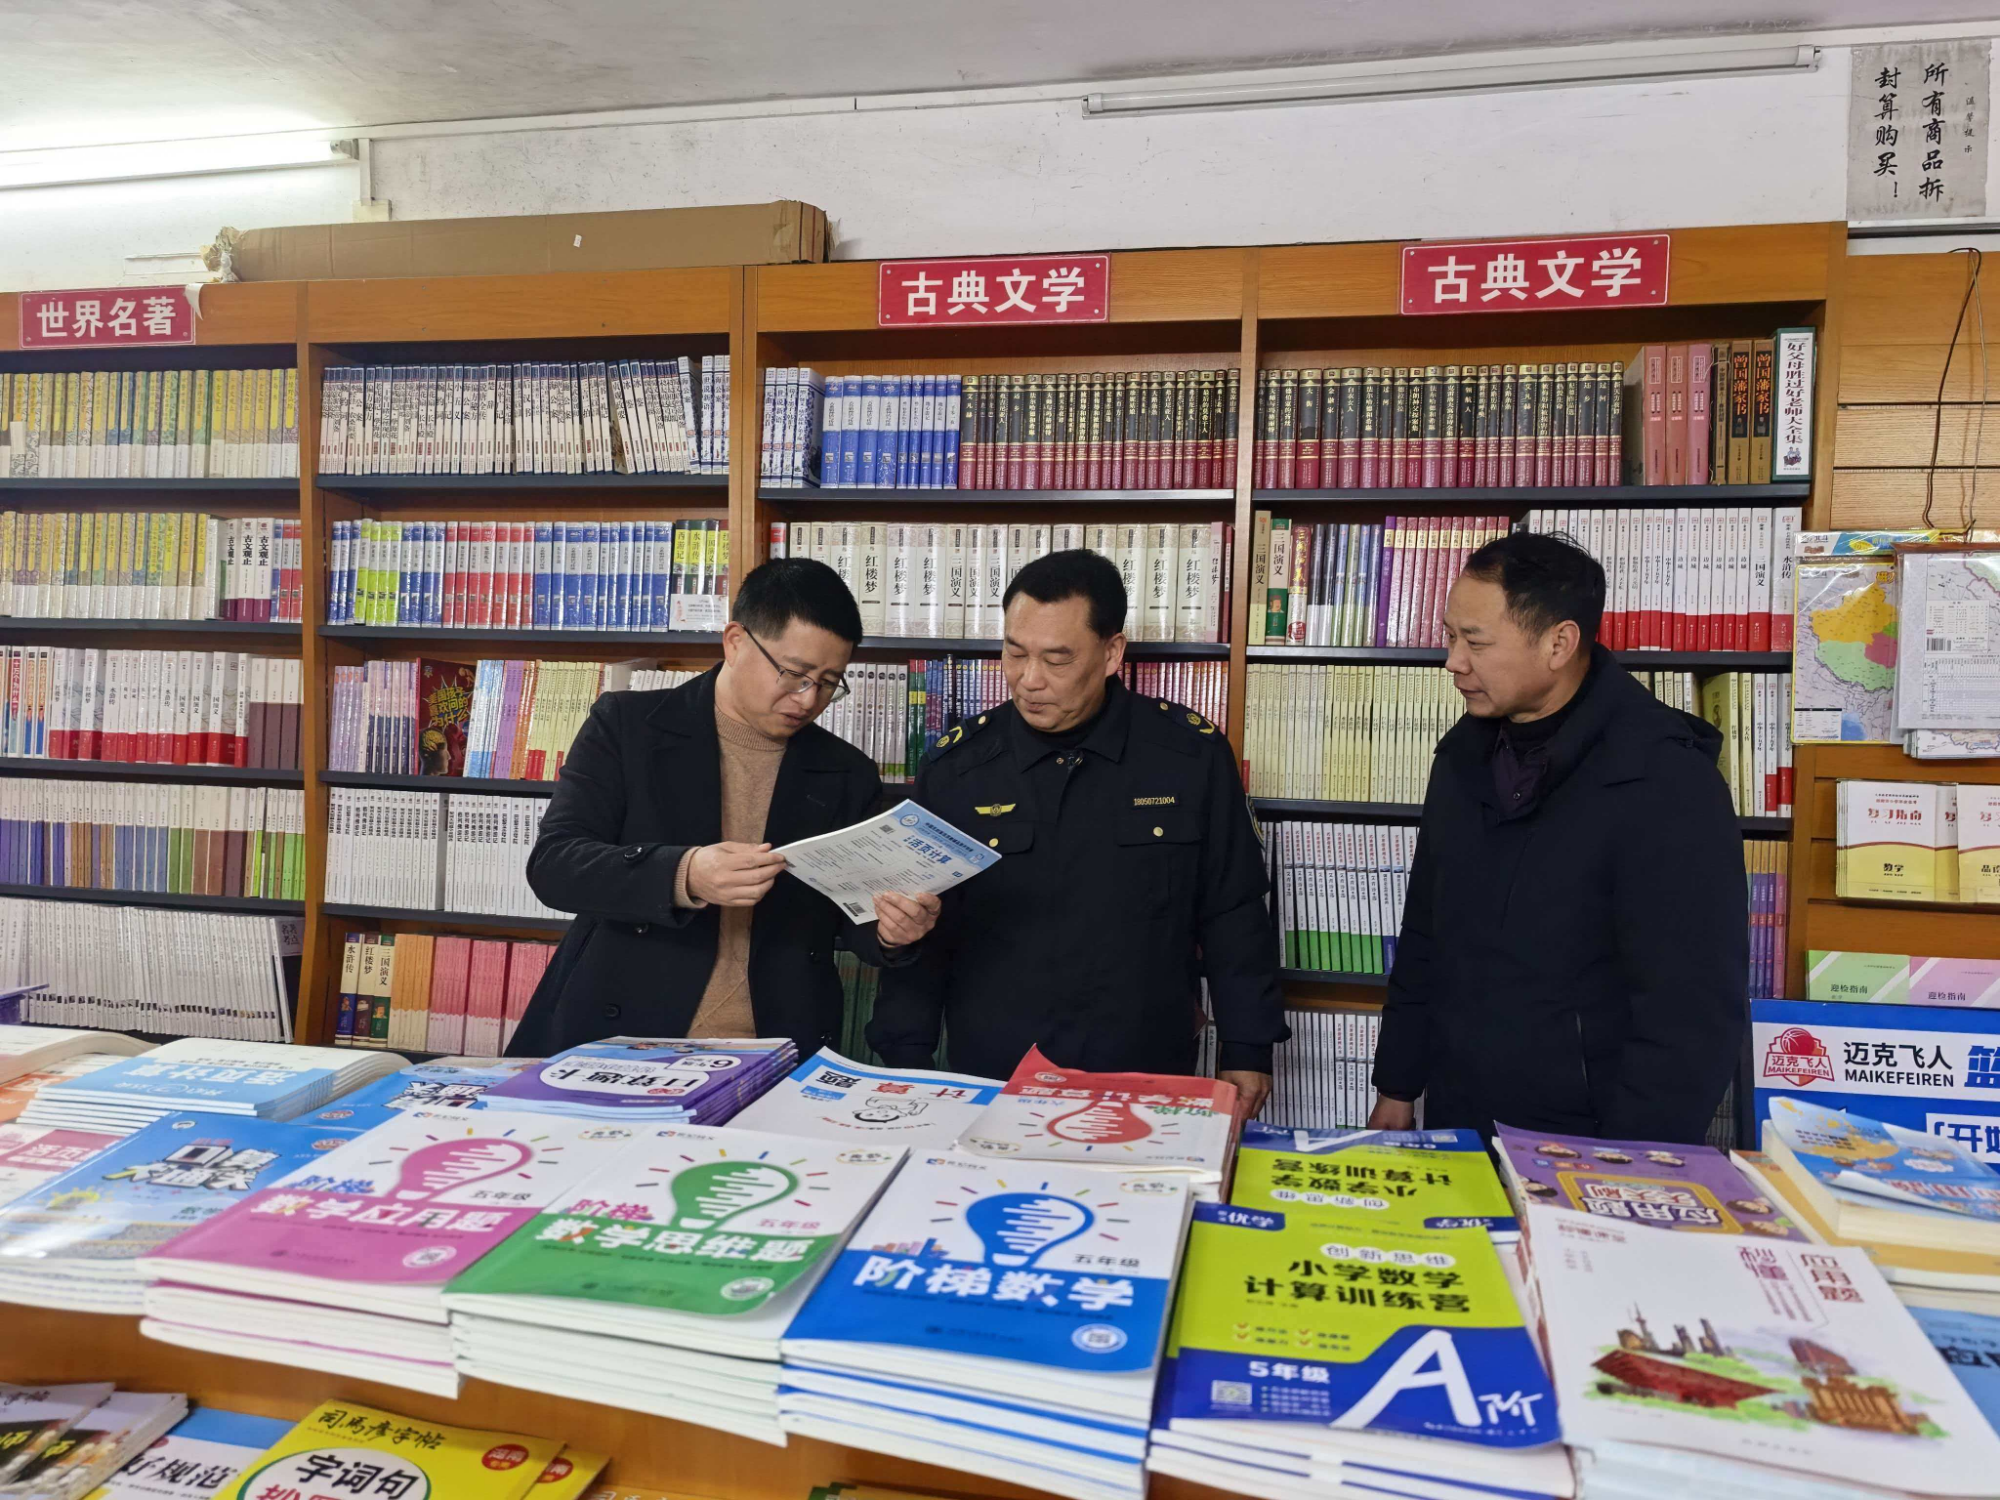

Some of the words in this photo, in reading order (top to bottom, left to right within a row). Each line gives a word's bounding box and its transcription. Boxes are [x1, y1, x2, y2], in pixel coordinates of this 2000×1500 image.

[1919, 62, 1949, 202] 所有商品拆
[1427, 247, 1642, 304] 古典文学
[901, 266, 1086, 317] 古典文学
[36, 296, 177, 338] 世界名著
[487, 382, 495, 411] 楚辞
[623, 381, 635, 408] 冰鉴
[633, 380, 645, 408] 冰鉴
[703, 376, 712, 410] 世说新语
[1733, 354, 1749, 416] 曾国藩家书
[1756, 353, 1771, 416] 曾国藩家书
[1785, 342, 1807, 444] 好父母胜过好老师大全集
[454, 382, 463, 421] 小五义
[612, 381, 627, 420] 贞观政要
[776, 388, 786, 424] 世说新语
[1201, 389, 1210, 433] 最后的莫希干人
[1411, 386, 1421, 432] 布朗神父探案集
[242, 535, 253, 566] 古文观止
[258, 536, 270, 567] 古文观止
[676, 532, 685, 561] 西游记
[691, 532, 701, 561] 水浒传
[706, 534, 716, 563] 三国演义
[1273, 532, 1285, 576] 三国演义
[865, 555, 878, 594] 红楼梦
[894, 557, 907, 595] 红楼梦
[923, 557, 936, 596] 红楼梦
[951, 556, 962, 598] 三国演义
[969, 556, 980, 598] 三国演义
[989, 556, 1001, 598] 三国演义
[1154, 558, 1168, 599] 红楼梦
[1186, 558, 1201, 599] 红楼梦
[1255, 544, 1267, 585] 三国演义
[1755, 555, 1767, 587] 三国演义
[1781, 555, 1793, 579] 水浒传
[431, 708, 469, 728] 为什么
[1867, 807, 1922, 821] 复习指南
[908, 836, 953, 866] 活页计算
[1883, 862, 1904, 874] 数学
[345, 945, 355, 974] 水浒传
[364, 946, 375, 975] 红楼梦
[379, 948, 391, 986] 三国演义
[1830, 983, 1868, 994] 迎检指南
[1928, 991, 1966, 1001] 迎检指南
[1767, 1065, 1830, 1077] MAIKEFEIREN
[1771, 1055, 1828, 1069] 迈克飞人
[1843, 1041, 1953, 1070] 迈克飞人
[549, 1068, 699, 1088] 口算题卡
[816, 1071, 967, 1099] 计算题
[1845, 1069, 1954, 1087] MAIKEFEIREN
[1271, 1158, 1452, 1186] 计算训练营
[1271, 1174, 1418, 1197] 小学数学
[469, 1189, 532, 1201] 五年级
[567, 1199, 655, 1221] 阶梯
[251, 1193, 513, 1233] 数学应用题
[757, 1217, 821, 1231] 五年级
[1580, 1198, 1722, 1224] 应用题
[535, 1217, 815, 1265] 数学思维题
[1325, 1245, 1449, 1267] 创新思维
[1074, 1253, 1140, 1268] 五年级
[1289, 1260, 1465, 1290] 小学数学
[853, 1255, 1134, 1310] 阶梯数学
[1244, 1275, 1470, 1313] 计算训练营
[1248, 1360, 1332, 1384] 5年级
[1329, 1329, 1483, 1429] A
[295, 1454, 420, 1500] 字词句
